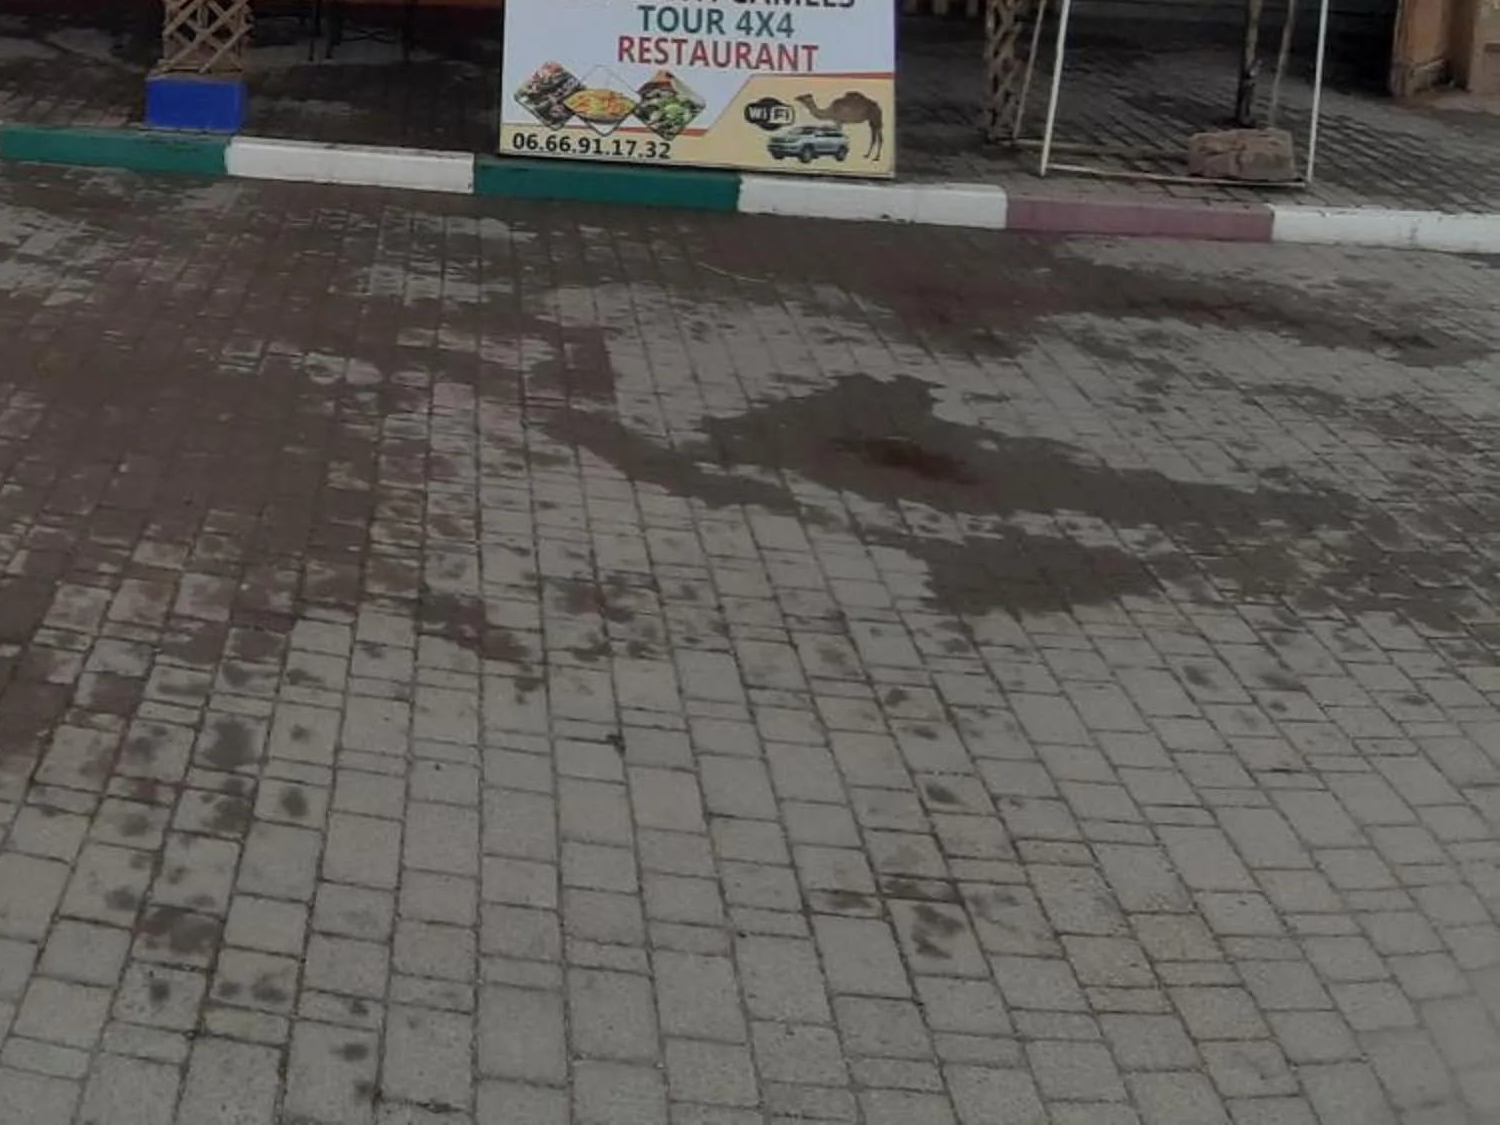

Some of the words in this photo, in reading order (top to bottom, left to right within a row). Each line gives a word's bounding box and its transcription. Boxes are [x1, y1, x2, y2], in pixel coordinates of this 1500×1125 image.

[637, 5, 725, 35] TOUR
[736, 11, 795, 38] 4X4
[618, 36, 819, 72] RESTAURANT
[512, 132, 671, 160] 06.66.91.17.32
